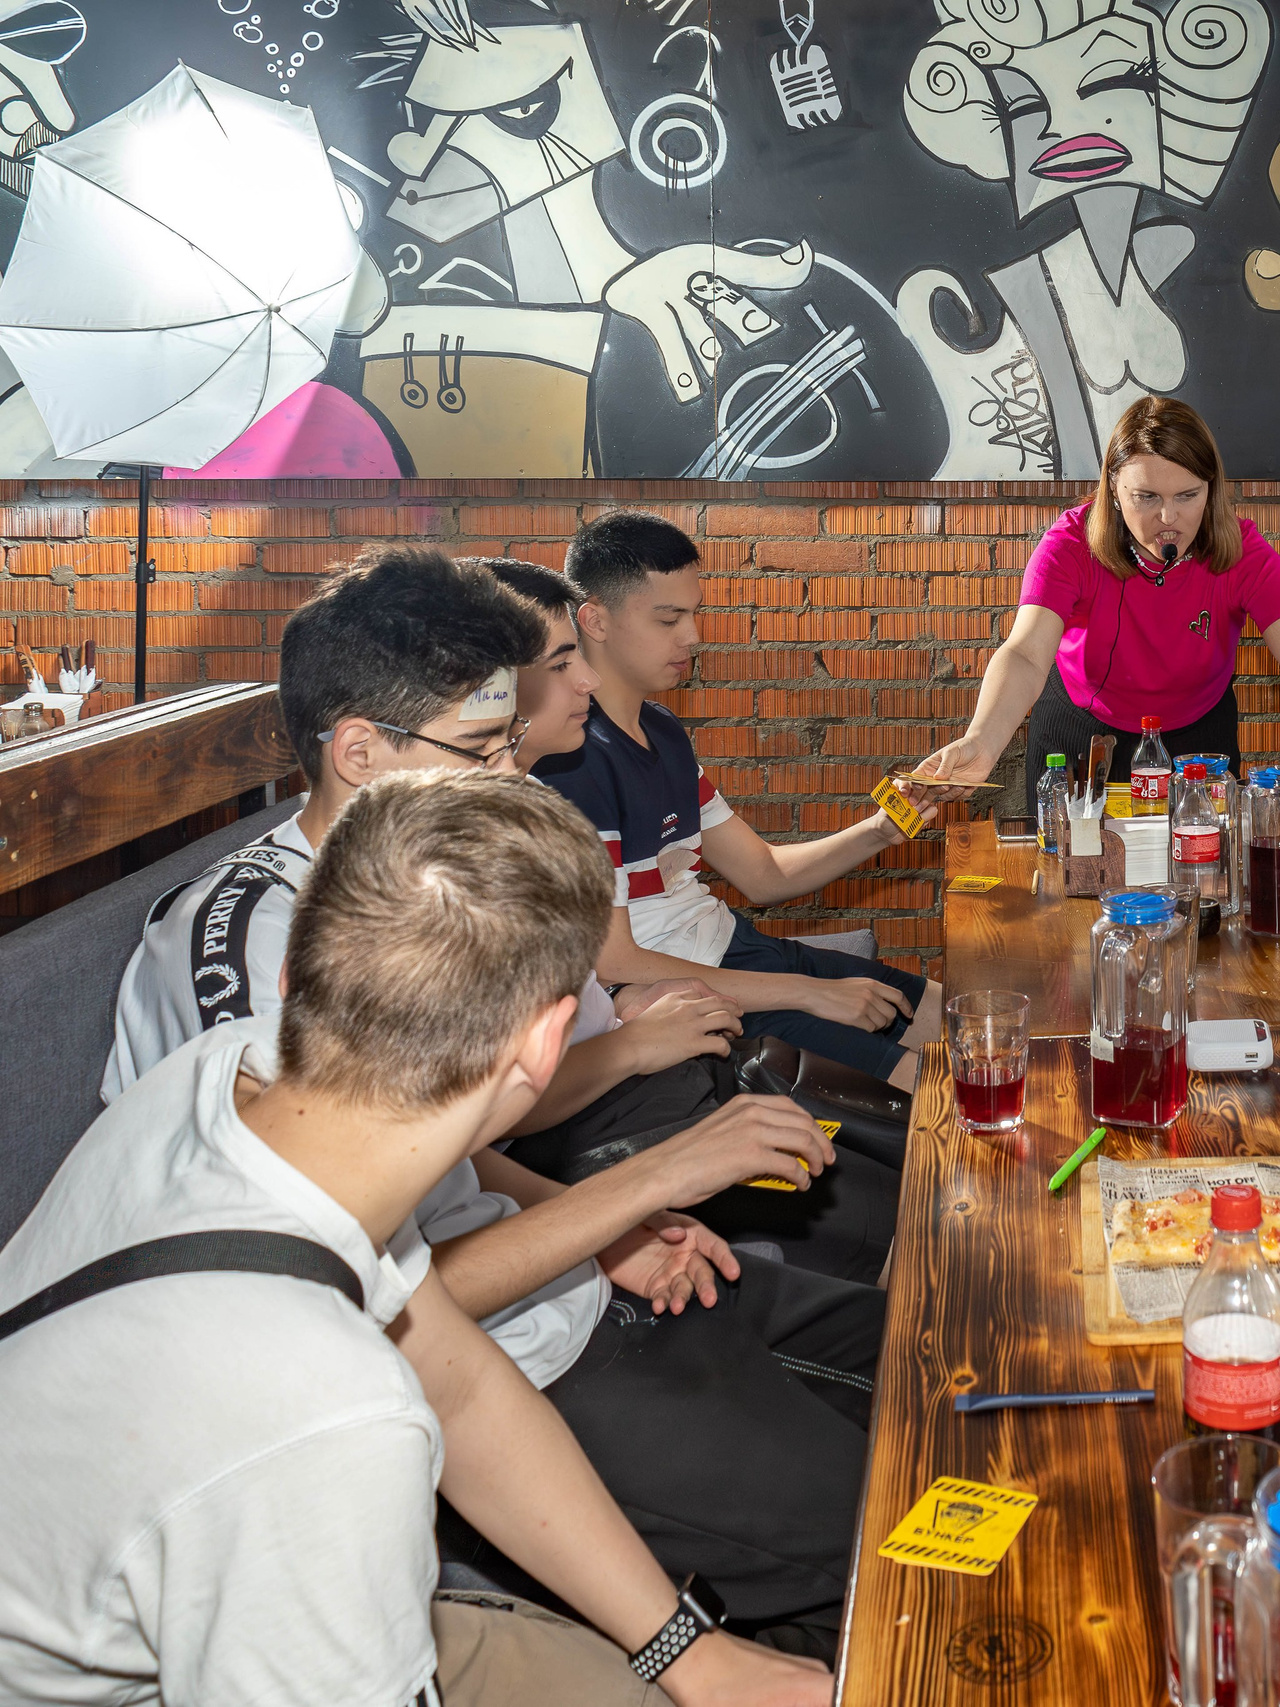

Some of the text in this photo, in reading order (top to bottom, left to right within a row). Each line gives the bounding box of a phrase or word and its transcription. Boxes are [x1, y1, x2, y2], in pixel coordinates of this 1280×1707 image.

[203, 887, 246, 957] PERRY
[1207, 1176, 1256, 1186] HOT OFF
[1101, 1186, 1149, 1200] SHAVE
[914, 1527, 974, 1543] БУНКЕР
